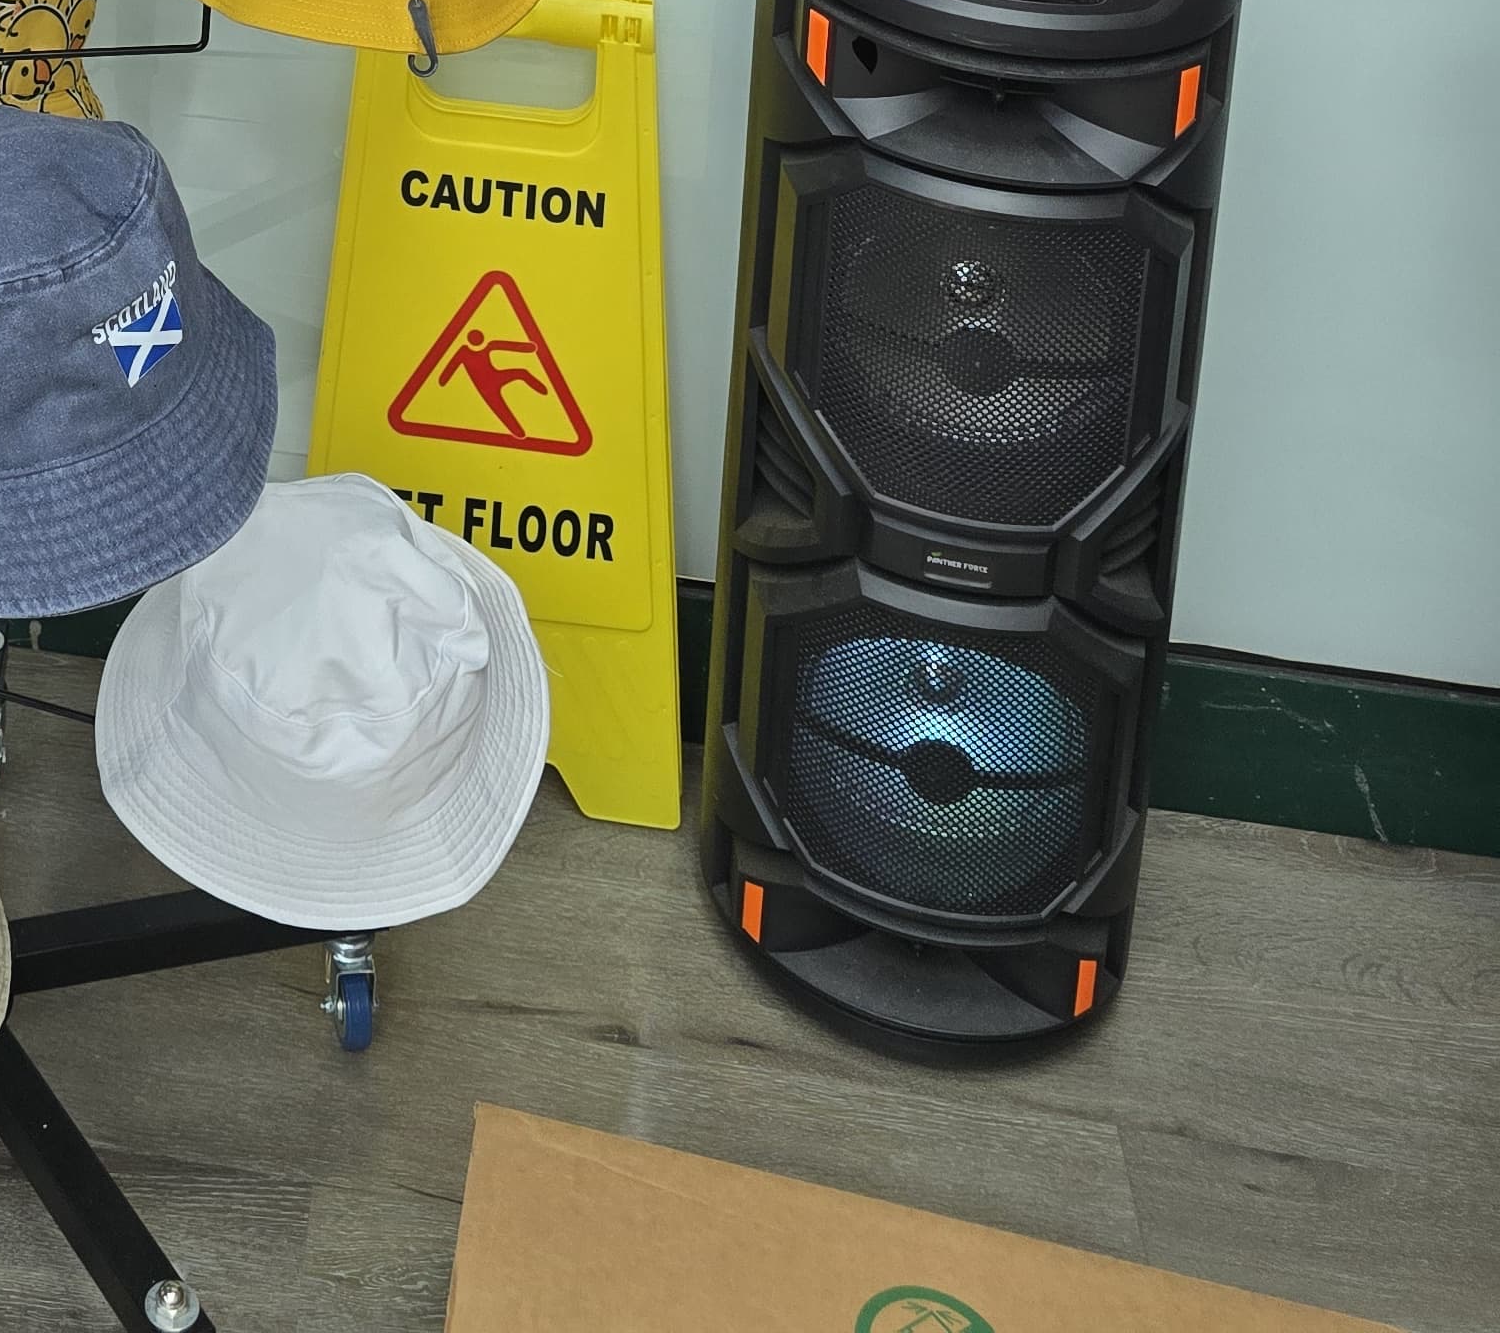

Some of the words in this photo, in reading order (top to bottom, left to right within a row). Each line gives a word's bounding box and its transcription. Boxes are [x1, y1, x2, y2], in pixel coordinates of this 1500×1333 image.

[400, 169, 606, 228] CAUTION
[91, 260, 178, 345] SCOTLAND
[463, 497, 615, 562] FLOOR
